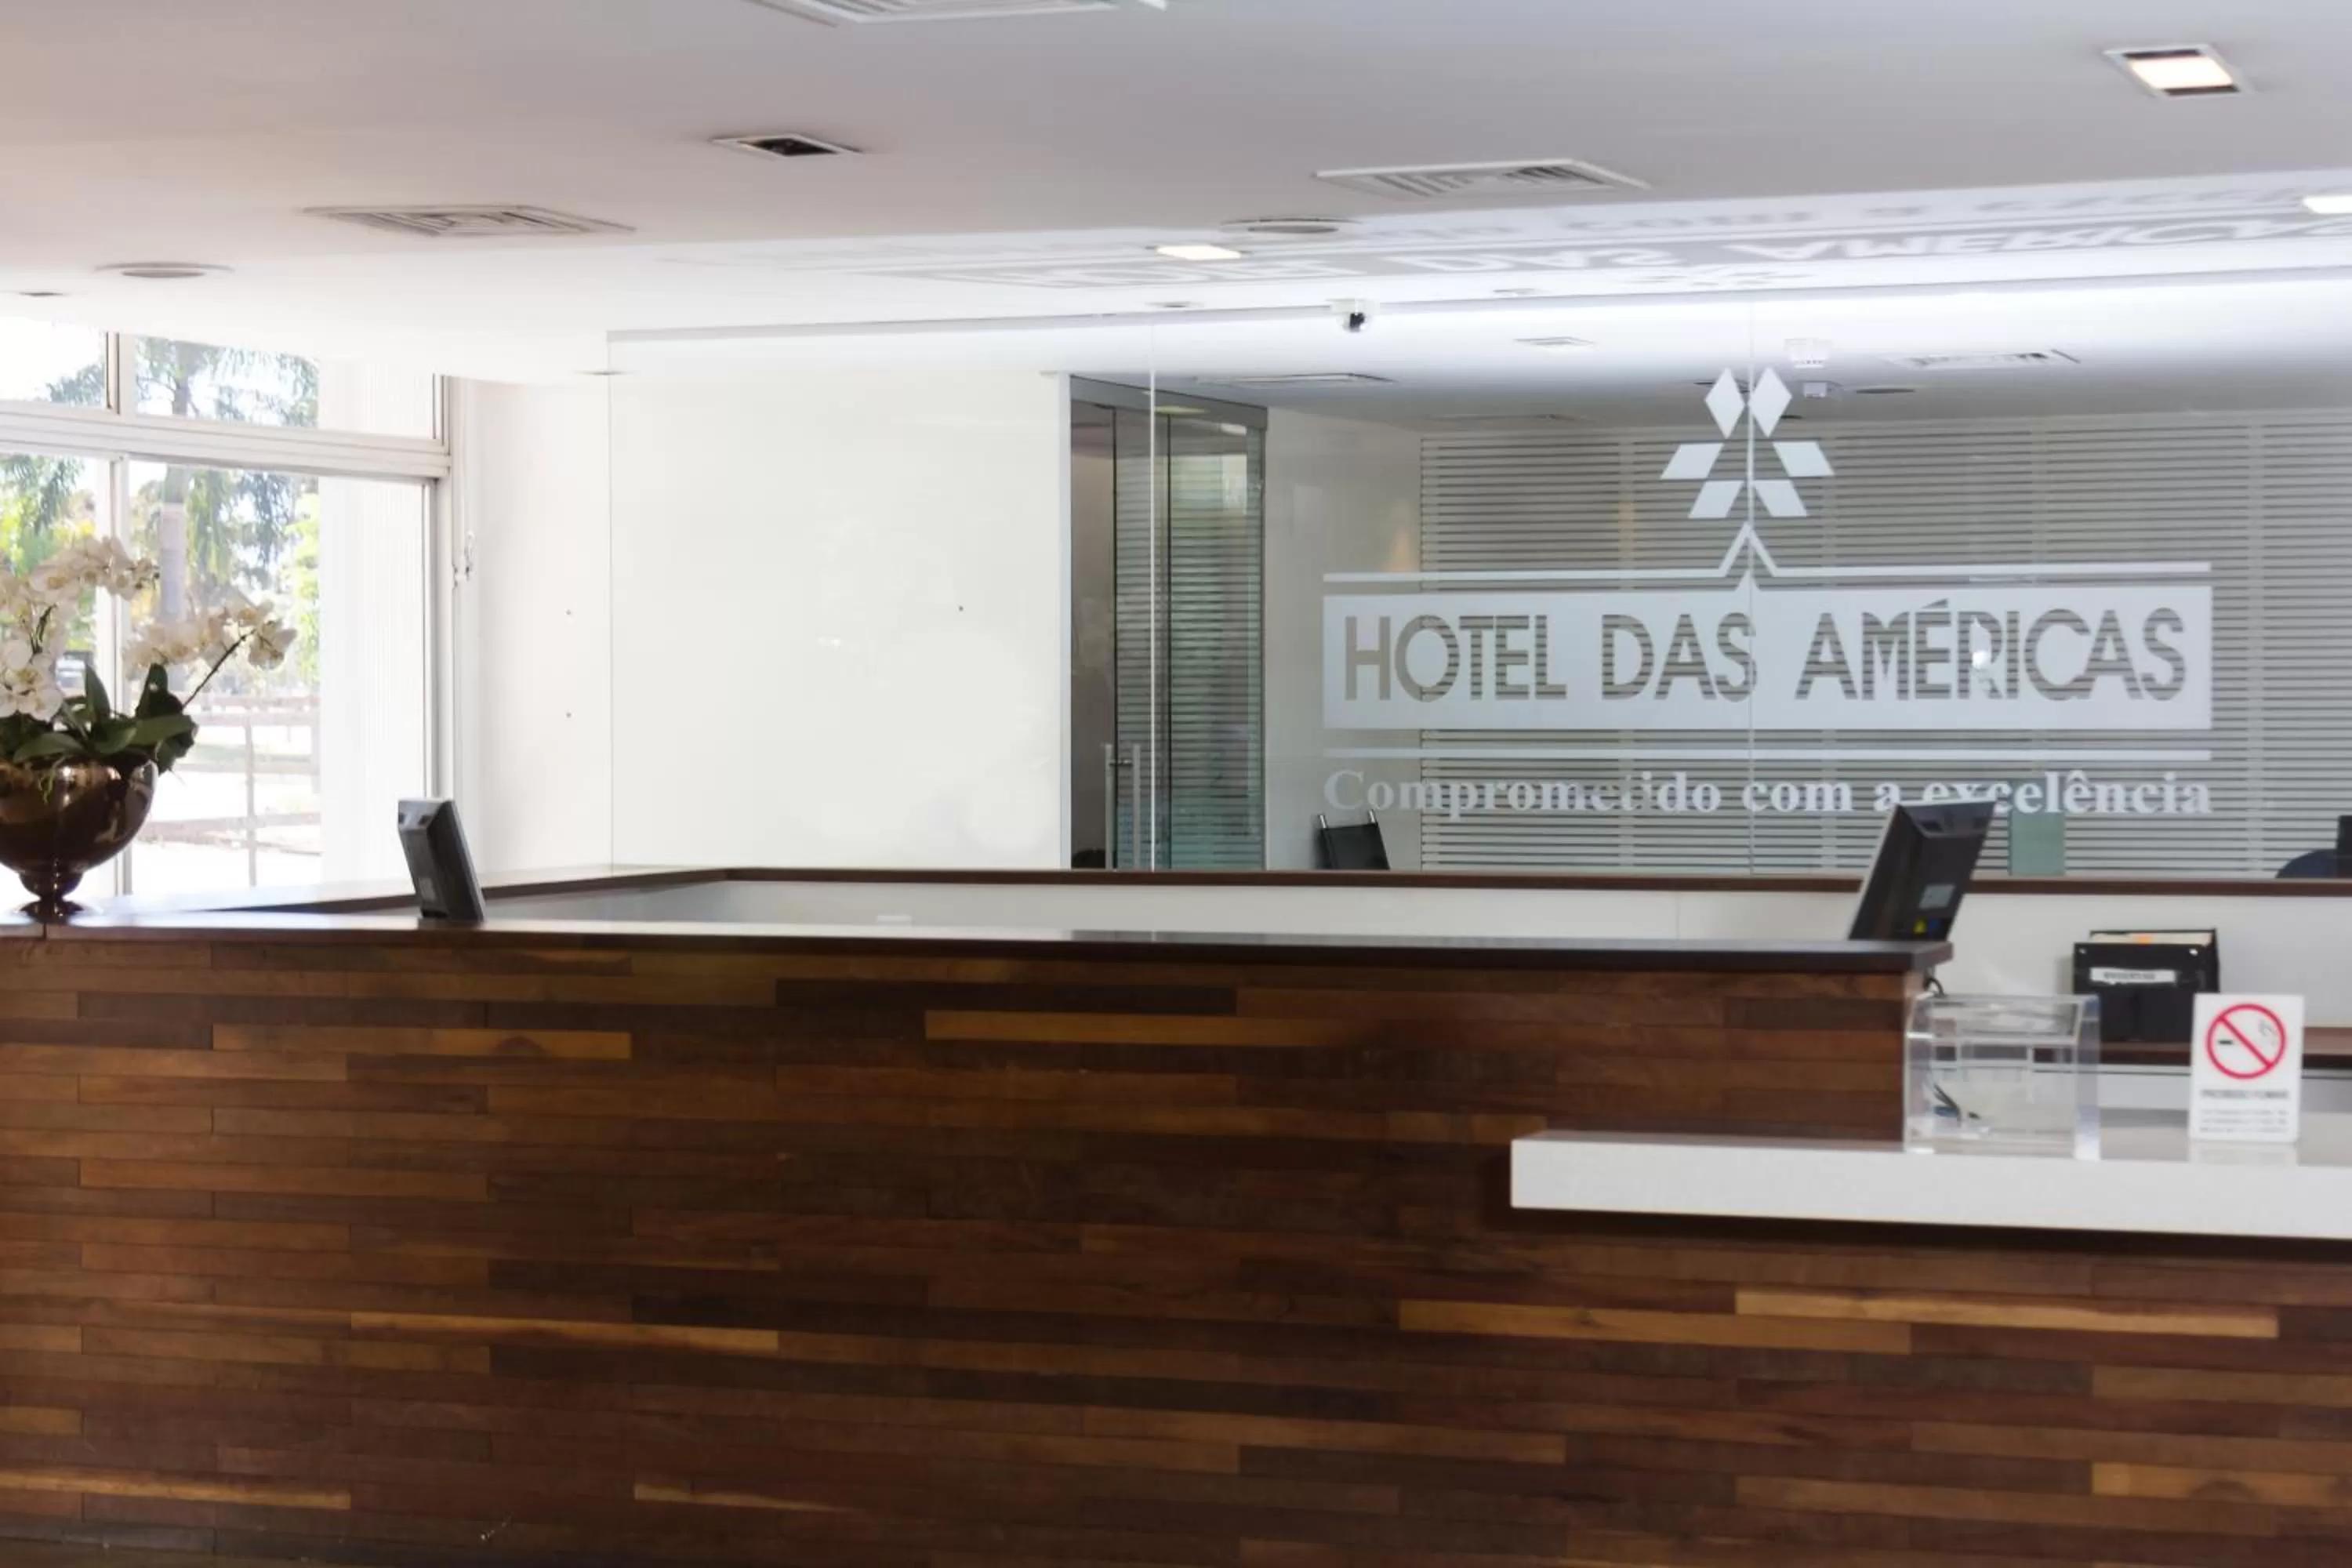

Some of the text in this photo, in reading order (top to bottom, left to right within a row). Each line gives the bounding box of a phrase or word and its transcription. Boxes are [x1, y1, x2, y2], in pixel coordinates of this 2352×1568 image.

[1345, 599, 2187, 702] HOTEL DAS AMÉRICAS
[1323, 769, 1721, 822] Comprometido
[1742, 782, 1852, 812] com
[1873, 782, 1900, 812] a
